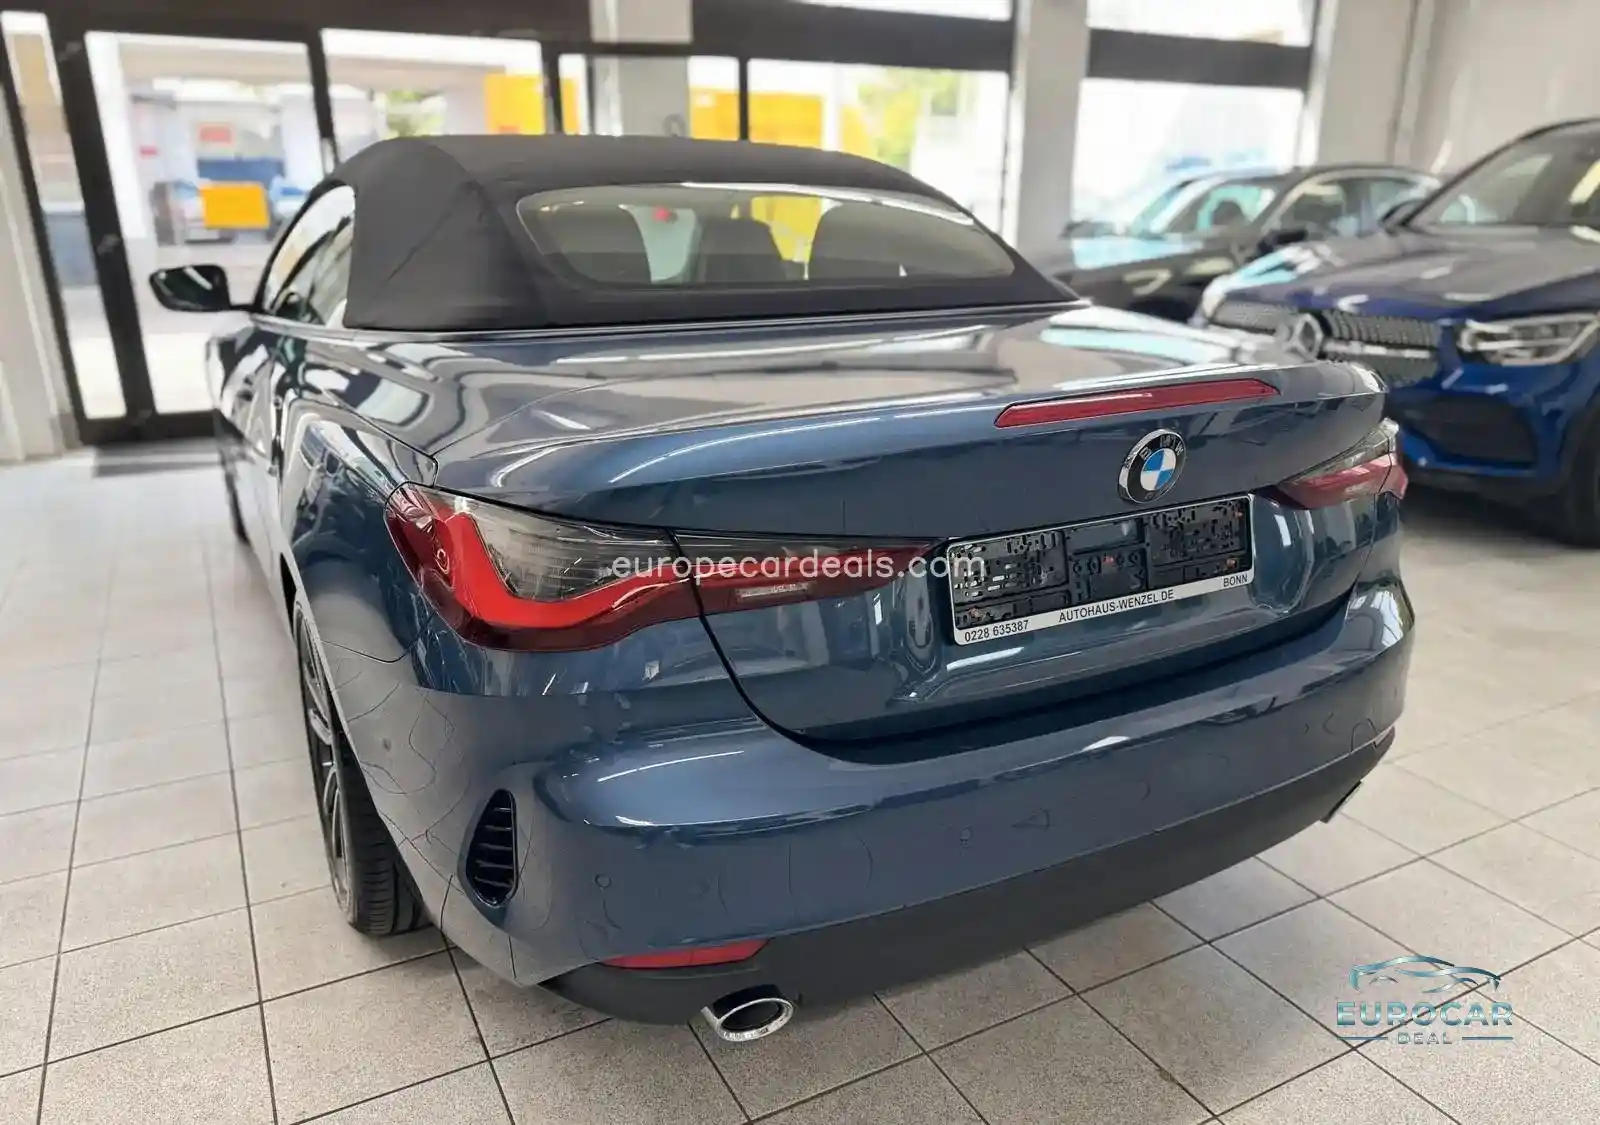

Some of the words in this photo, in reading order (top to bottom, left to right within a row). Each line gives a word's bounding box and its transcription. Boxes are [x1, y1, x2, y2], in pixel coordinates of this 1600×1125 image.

[964, 627, 990, 643] 0228
[992, 619, 1029, 637] 635387
[1223, 573, 1248, 588] BONN
